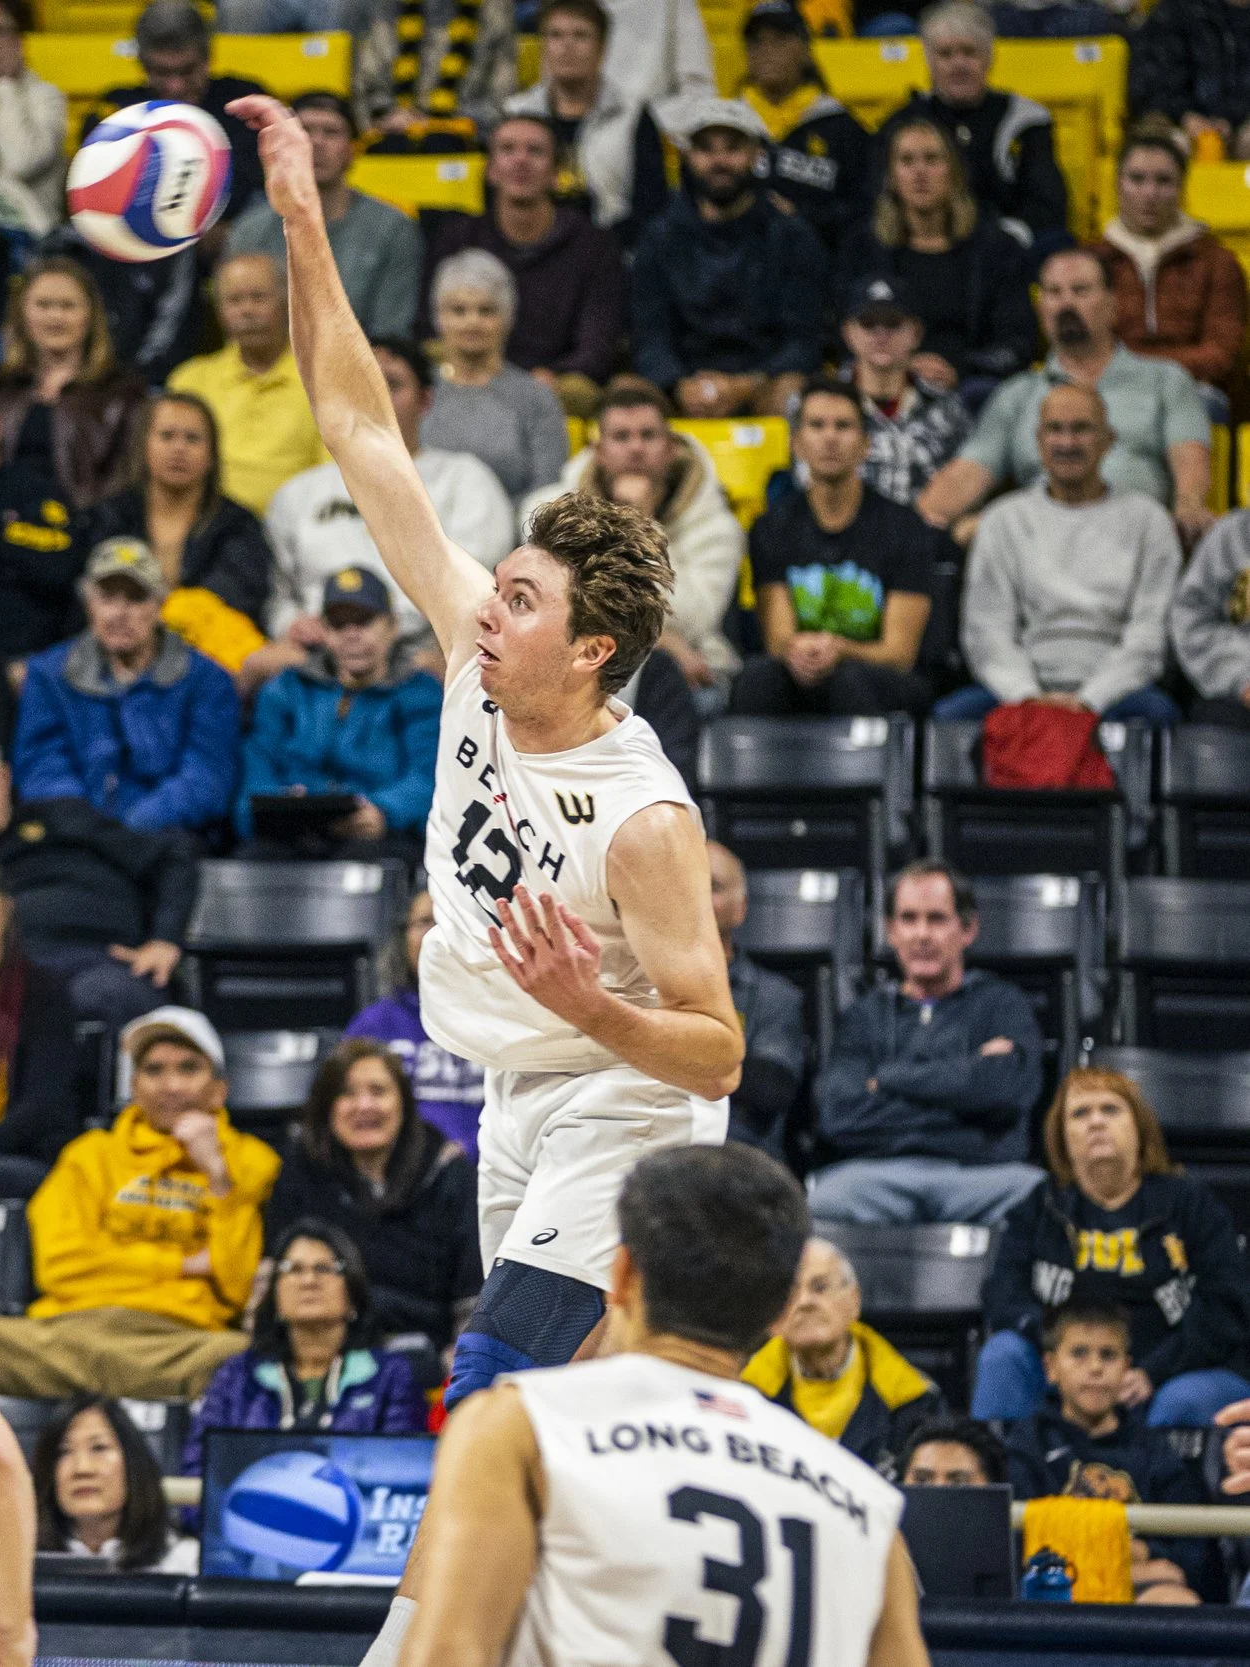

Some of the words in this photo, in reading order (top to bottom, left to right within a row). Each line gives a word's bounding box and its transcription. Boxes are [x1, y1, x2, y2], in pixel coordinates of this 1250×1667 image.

[586, 1423, 711, 1454] LONG
[725, 1431, 869, 1537] BEACH
[662, 1485, 817, 1667] 31
